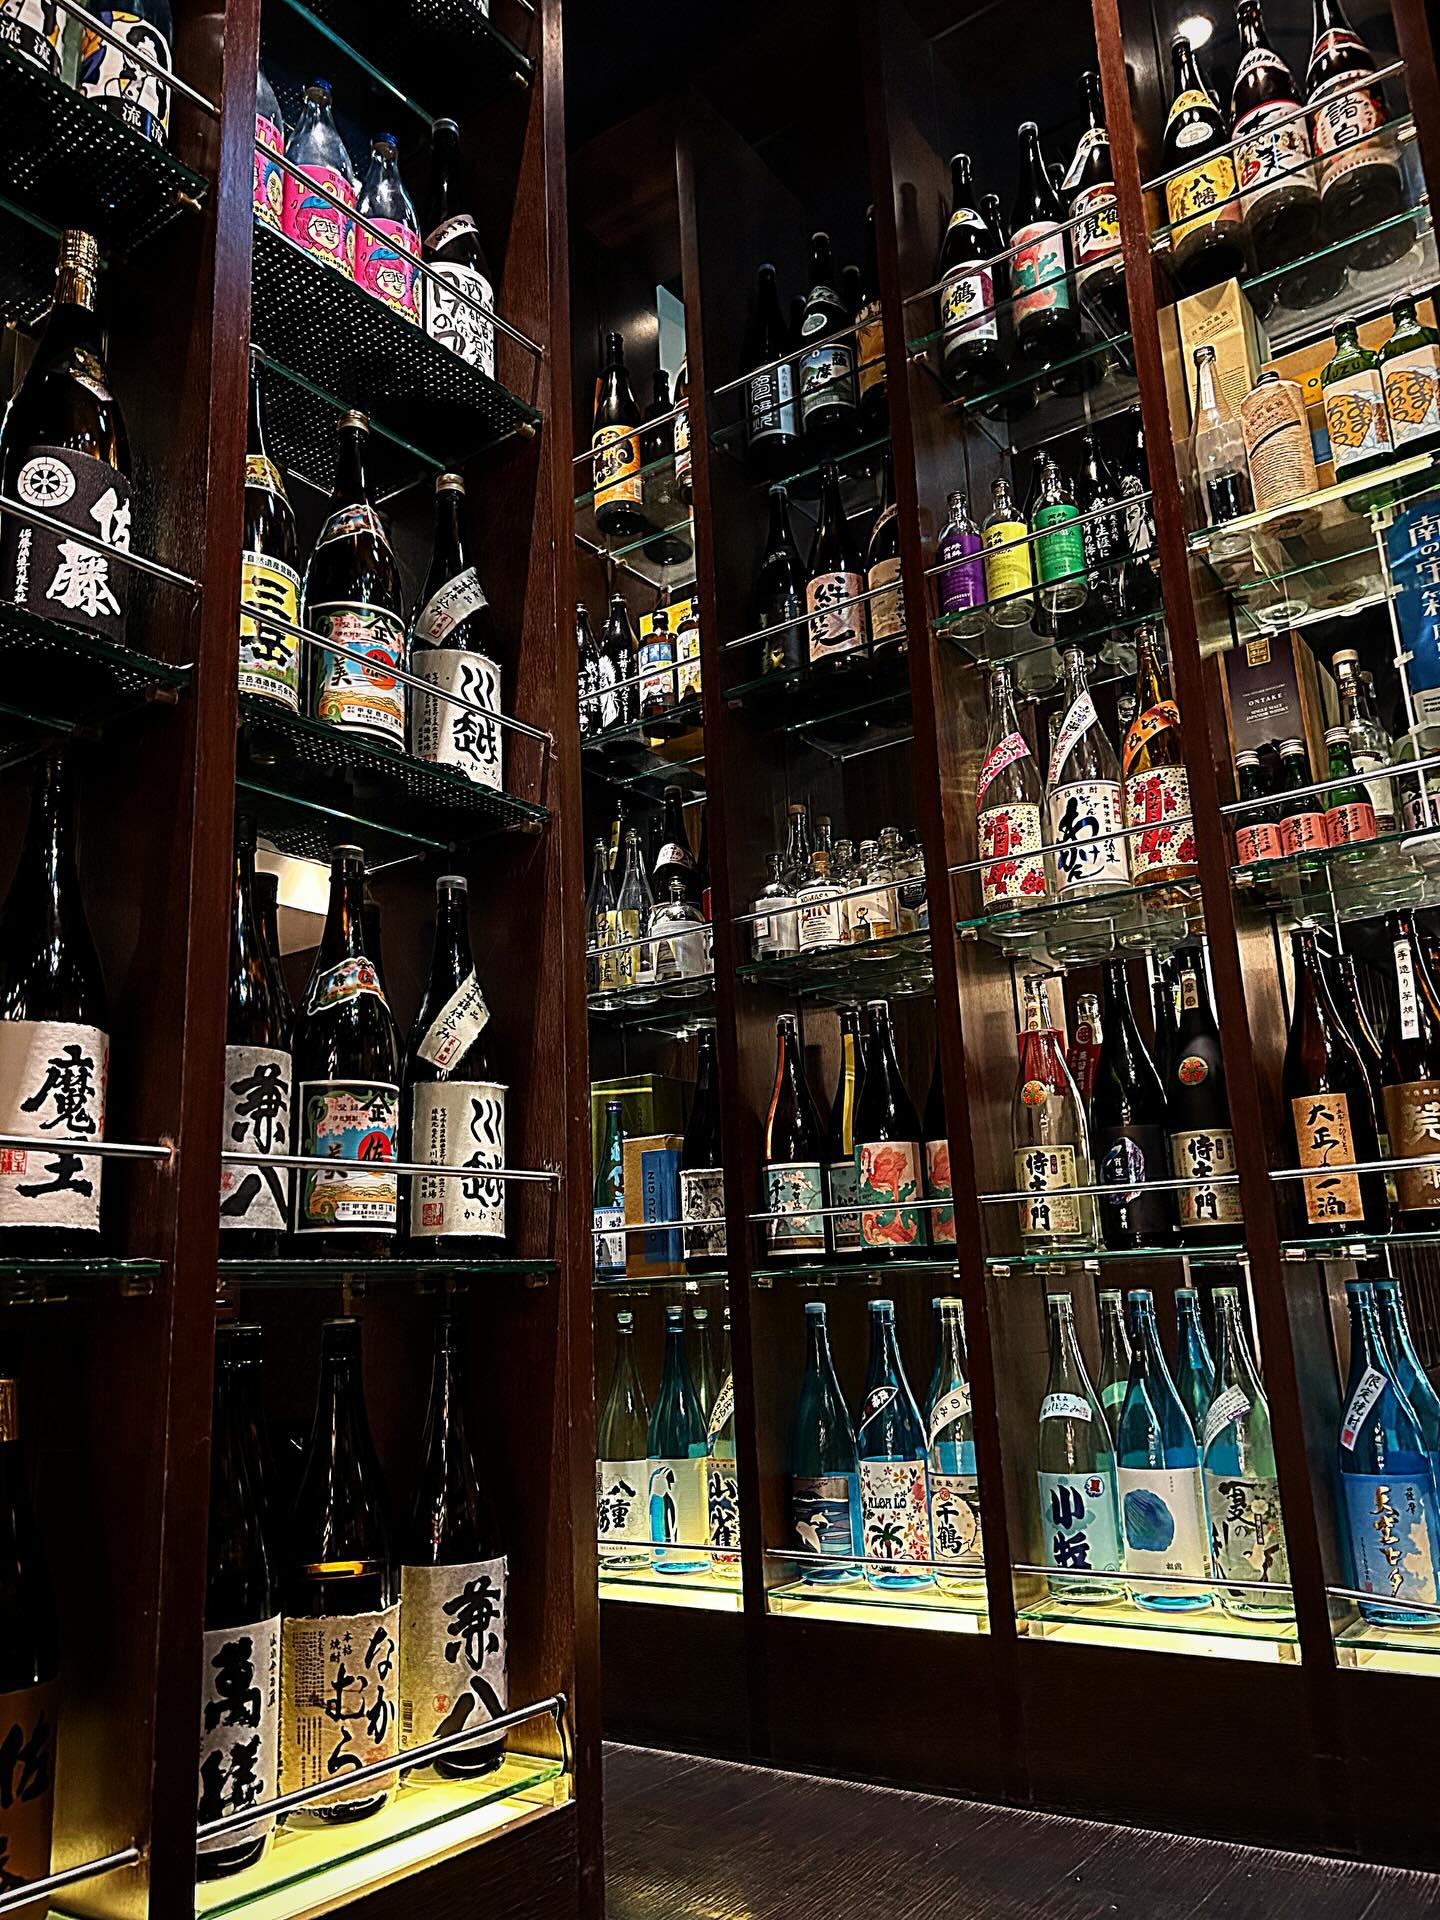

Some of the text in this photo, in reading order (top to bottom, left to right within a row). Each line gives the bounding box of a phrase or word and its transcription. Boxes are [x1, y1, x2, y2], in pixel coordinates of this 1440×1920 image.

[1190, 173, 1218, 207] 八幡
[46, 487, 132, 618] 佐藤
[1248, 692, 1284, 706] ONTAKE
[16, 1044, 97, 1198] 魔王
[220, 1062, 289, 1221] 兼八
[935, 1501, 963, 1554] 千鶴
[432, 1575, 502, 1742] 兼八
